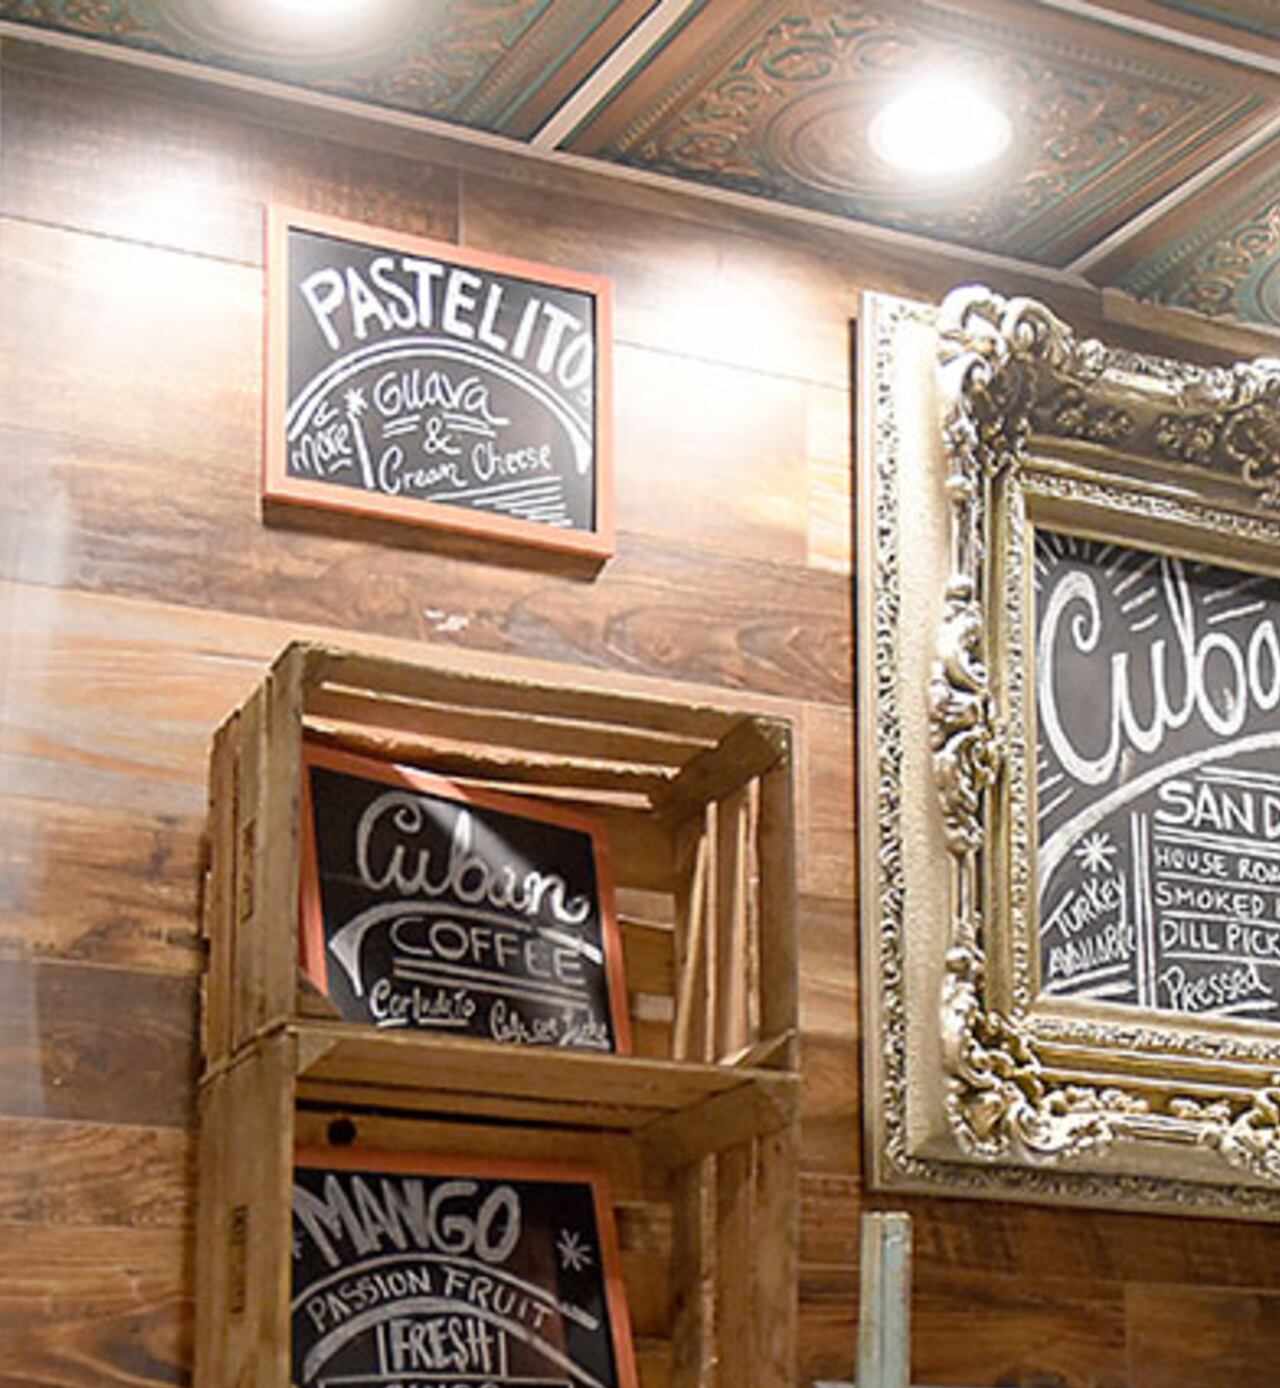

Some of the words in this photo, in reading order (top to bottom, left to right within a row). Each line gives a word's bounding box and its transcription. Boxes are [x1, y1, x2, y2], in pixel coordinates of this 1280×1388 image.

[374, 369, 510, 426] Guava
[379, 446, 467, 494] Cream
[471, 438, 551, 481] Cheese
[357, 790, 590, 924] Cuban
[1154, 846, 1228, 877] HOUSE
[1154, 881, 1265, 919] SMOKED
[389, 916, 587, 985] COFFEE
[1160, 920, 1220, 951] DILL
[293, 1174, 521, 1268] MANGO
[306, 1267, 432, 1331] PASSION
[442, 1265, 554, 1328] FRUIT
[388, 1316, 493, 1373] FRESH
